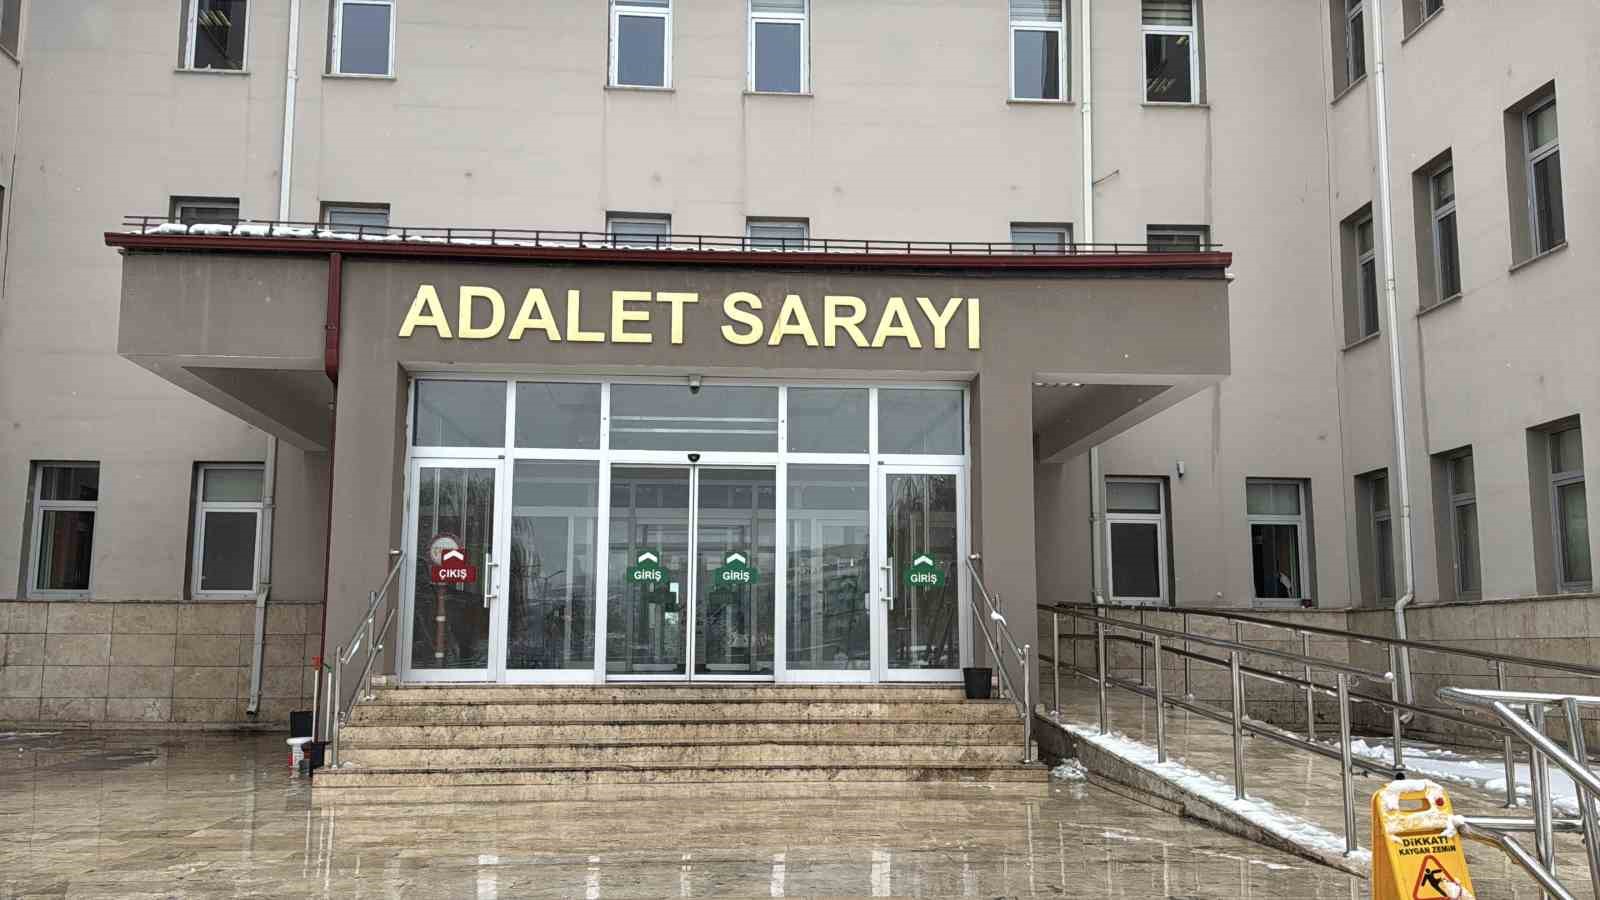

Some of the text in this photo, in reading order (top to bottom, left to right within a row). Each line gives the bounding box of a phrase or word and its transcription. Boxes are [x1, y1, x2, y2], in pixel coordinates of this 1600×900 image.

[398, 284, 982, 350] ADALET SARAYI
[439, 568, 467, 580] ÇIKIŞ
[634, 568, 662, 581] GİRİŞ
[722, 569, 750, 582] GİRİŞ
[910, 571, 937, 584] GİRİŞ
[1399, 845, 1456, 855] KAYGAN ZEMİN
